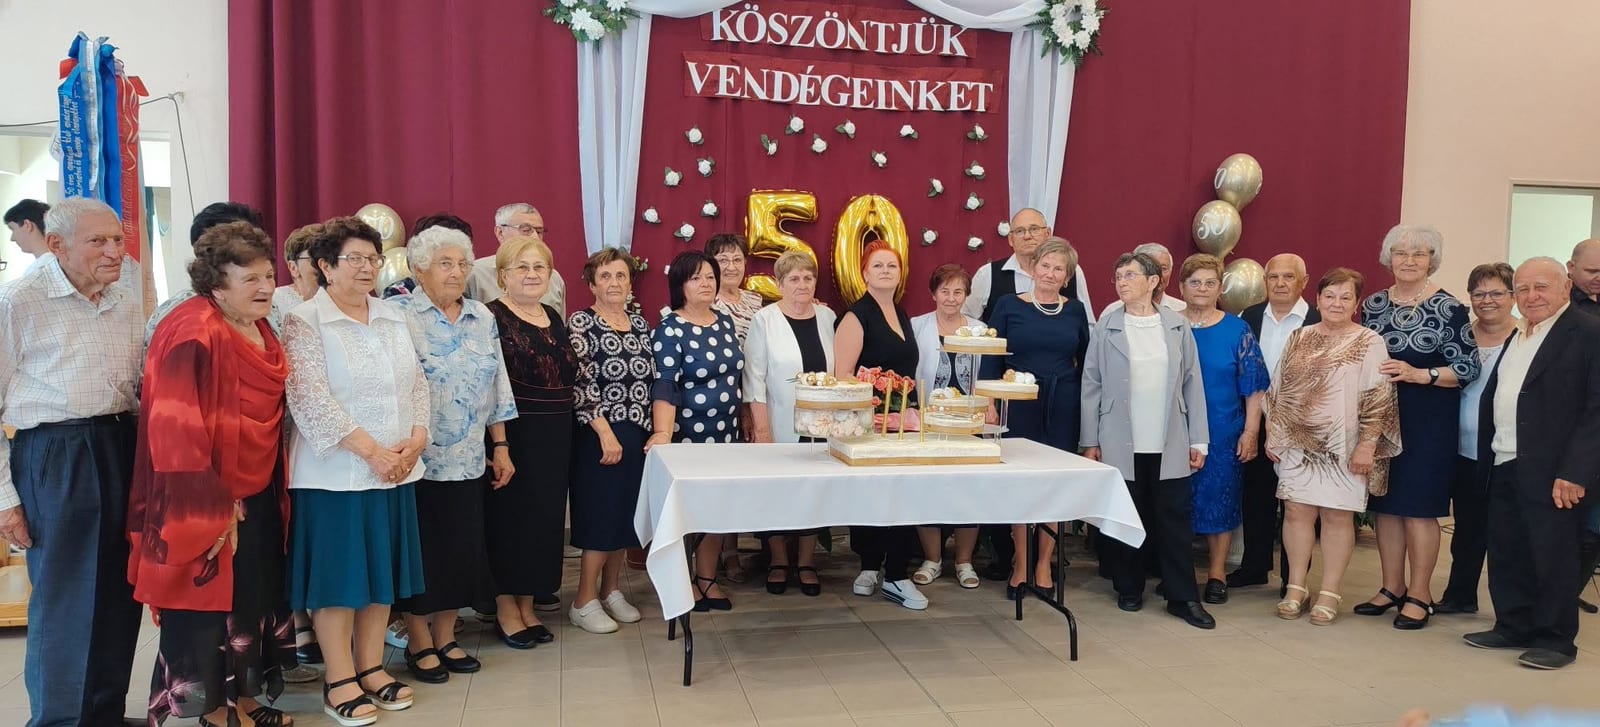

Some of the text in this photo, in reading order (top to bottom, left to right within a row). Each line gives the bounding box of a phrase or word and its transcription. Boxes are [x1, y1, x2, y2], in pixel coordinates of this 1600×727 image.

[711, 3, 968, 57] KÖSZÖNTJÜK
[686, 61, 993, 112] VENDÉGEINKET
[745, 188, 909, 305] 50
[1197, 212, 1230, 240] 50
